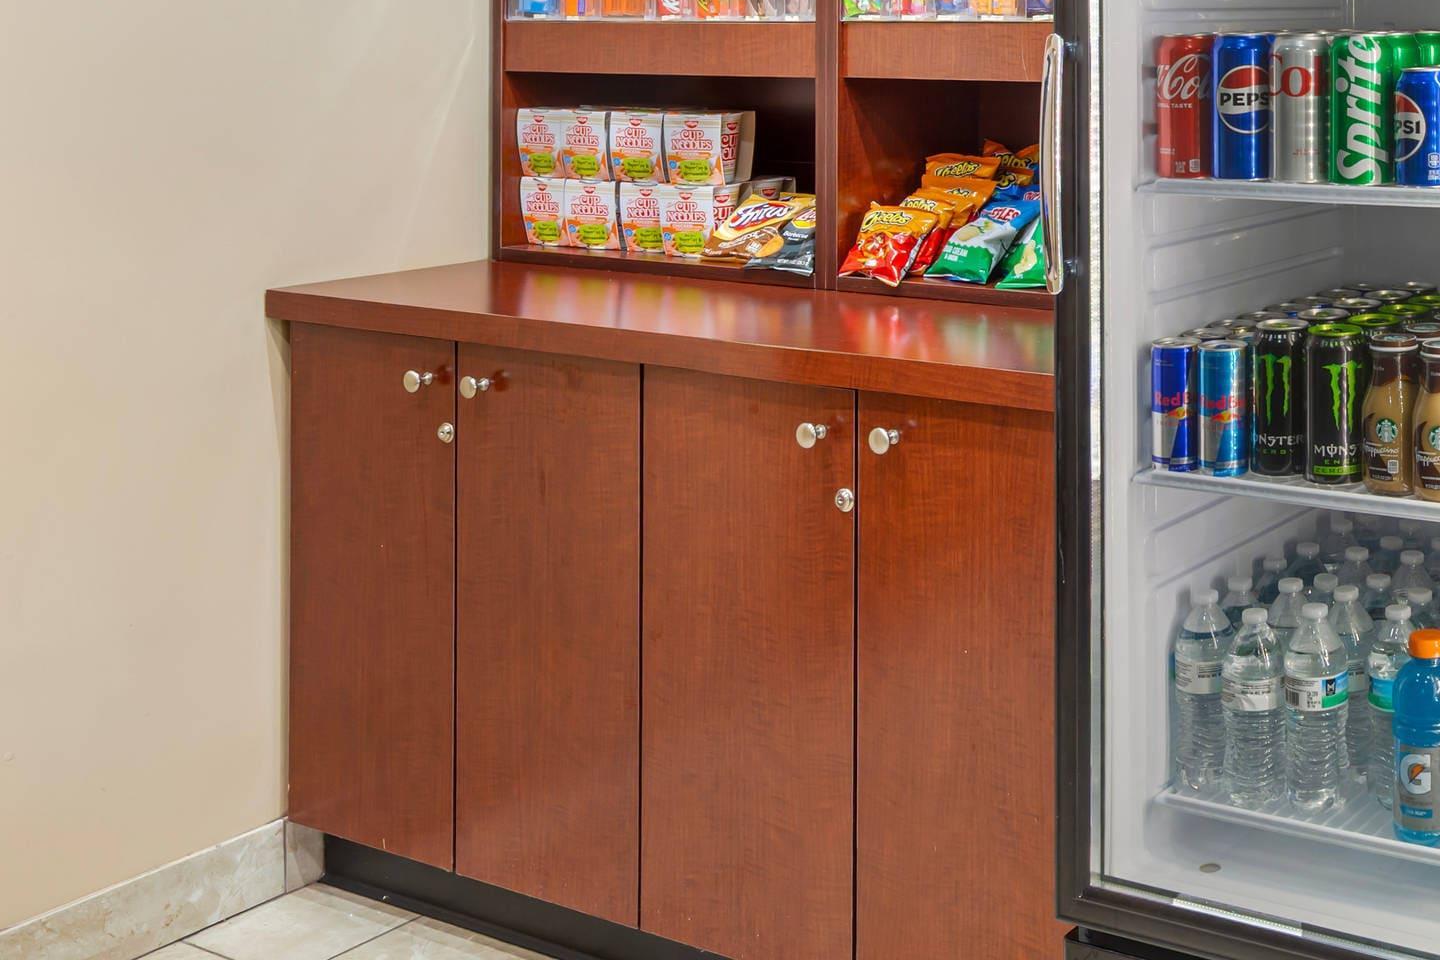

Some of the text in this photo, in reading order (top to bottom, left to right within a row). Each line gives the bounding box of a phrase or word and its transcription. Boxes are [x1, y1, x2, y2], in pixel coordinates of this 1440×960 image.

[1220, 92, 1269, 107] PEPS
[1336, 33, 1389, 185] Sprite
[681, 129, 704, 140] CUP
[672, 139, 712, 150] NOODLES
[635, 198, 657, 208] CUP
[675, 202, 697, 212] CUP
[627, 207, 660, 218] NOODLE
[666, 211, 706, 222] NOODLES
[729, 202, 793, 228] Fritos
[860, 210, 912, 232] Cheetos
[1155, 392, 1180, 406] Red
[1400, 754, 1431, 795] G
